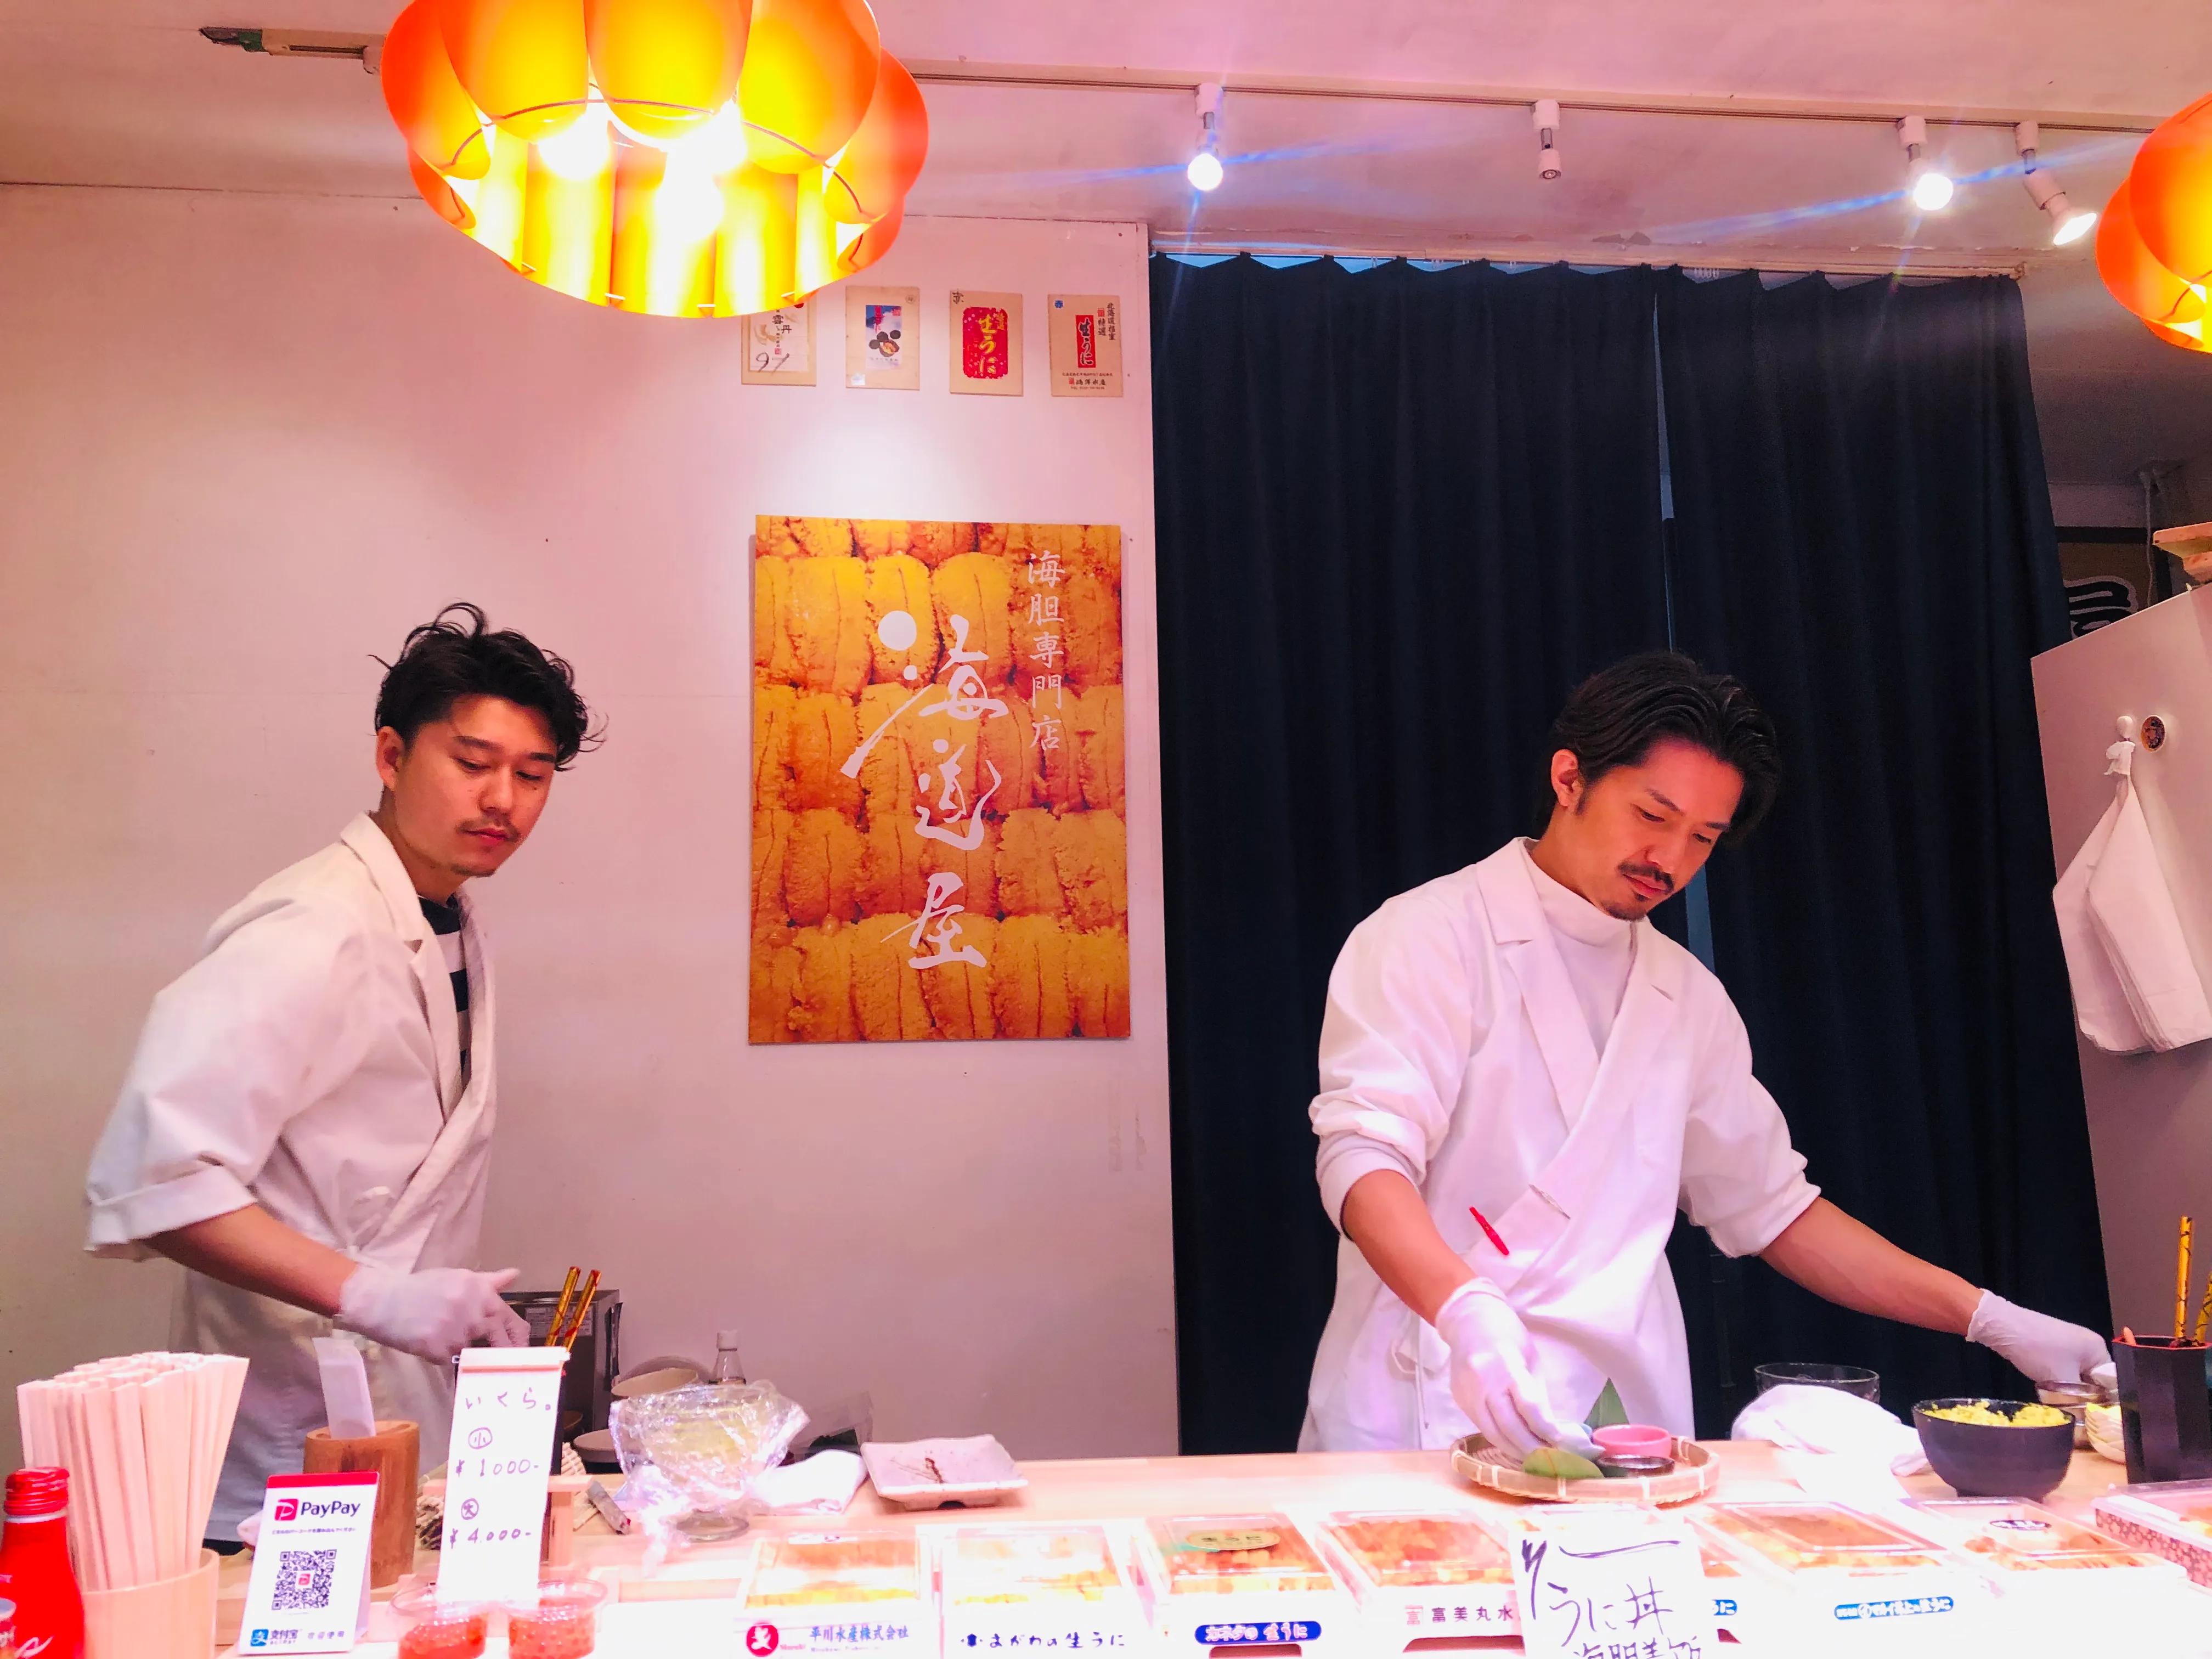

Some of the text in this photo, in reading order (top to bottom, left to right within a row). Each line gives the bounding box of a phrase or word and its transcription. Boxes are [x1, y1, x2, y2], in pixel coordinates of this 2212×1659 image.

[978, 314, 998, 375] 生うに
[1079, 317, 1093, 365] 生うに
[1028, 550, 1065, 752] 海胆専門店
[840, 610, 1008, 970] 海道屋
[301, 1500, 361, 1518] PayPay
[810, 1624, 909, 1643] 平川水産株式会社
[1431, 1605, 1514, 1622] 富美丸水
[1547, 1576, 1674, 1647] うに丼
